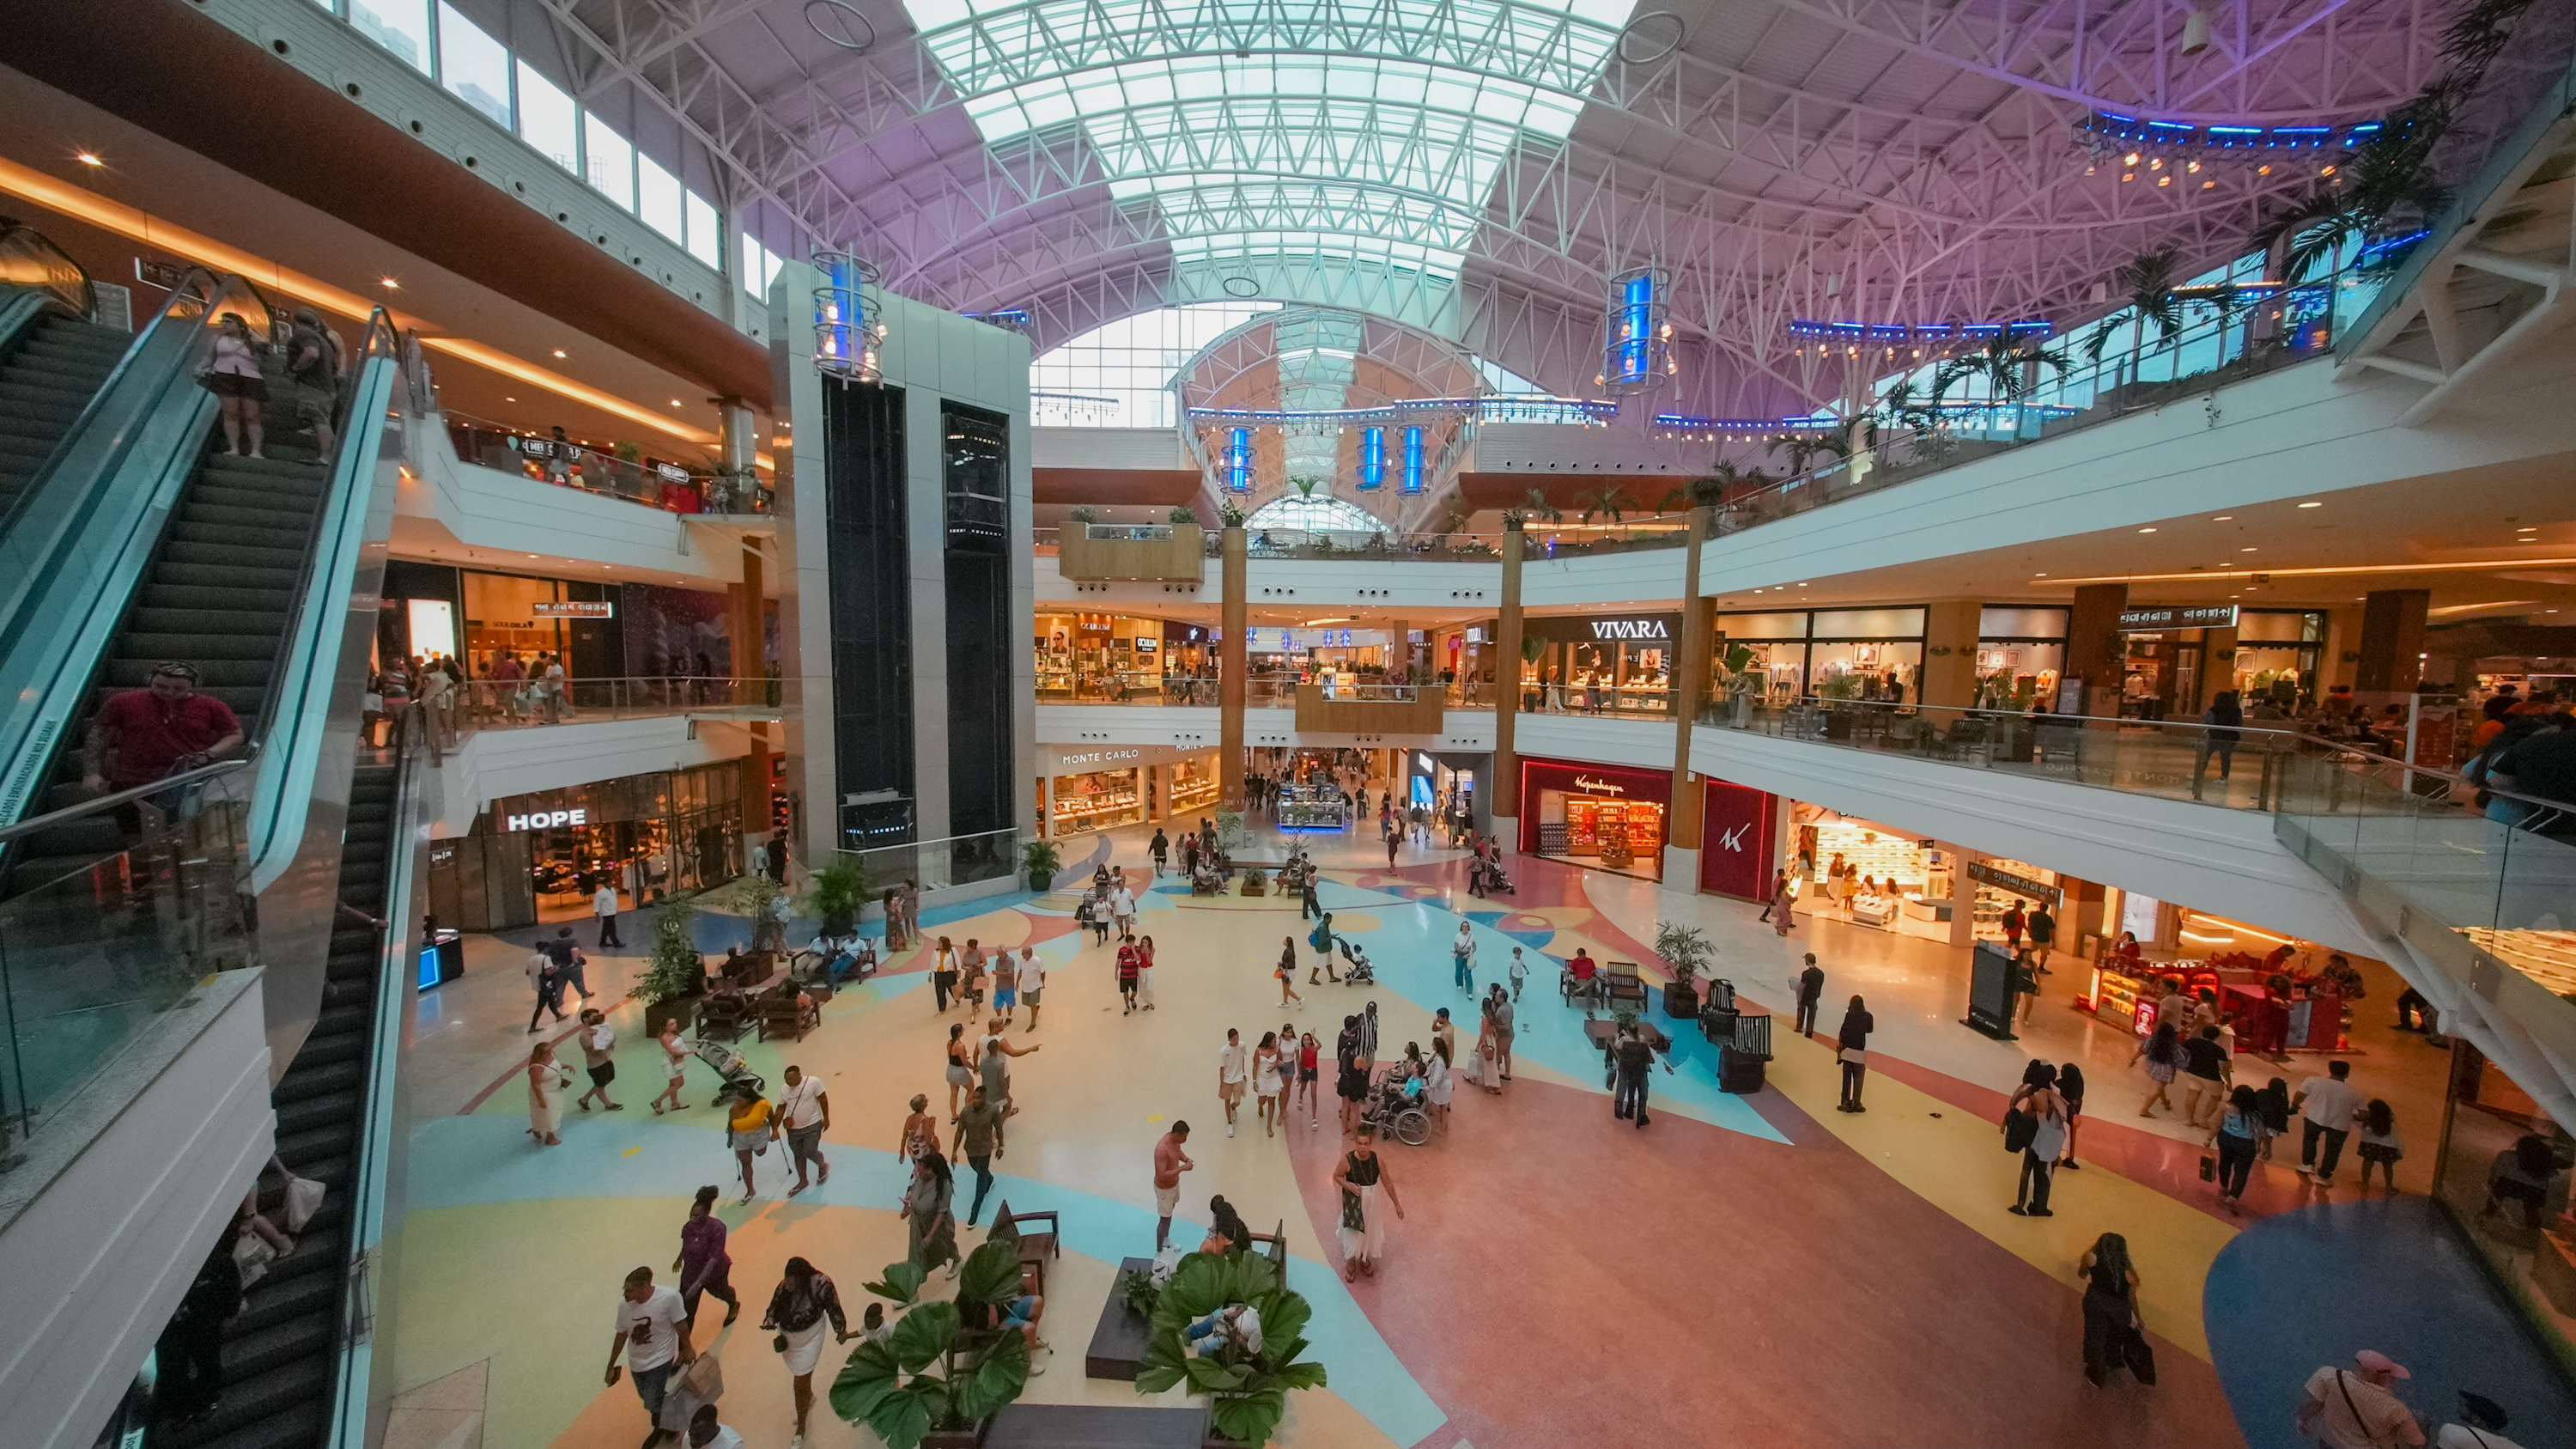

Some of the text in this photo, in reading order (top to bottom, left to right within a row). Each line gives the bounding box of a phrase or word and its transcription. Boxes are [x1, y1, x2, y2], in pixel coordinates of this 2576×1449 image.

[1591, 620, 1668, 639] VIVARA
[1062, 749, 1139, 764] MONTE CARLO
[1575, 775, 1624, 796] Kopenhagen
[508, 809, 586, 831] HOPE
